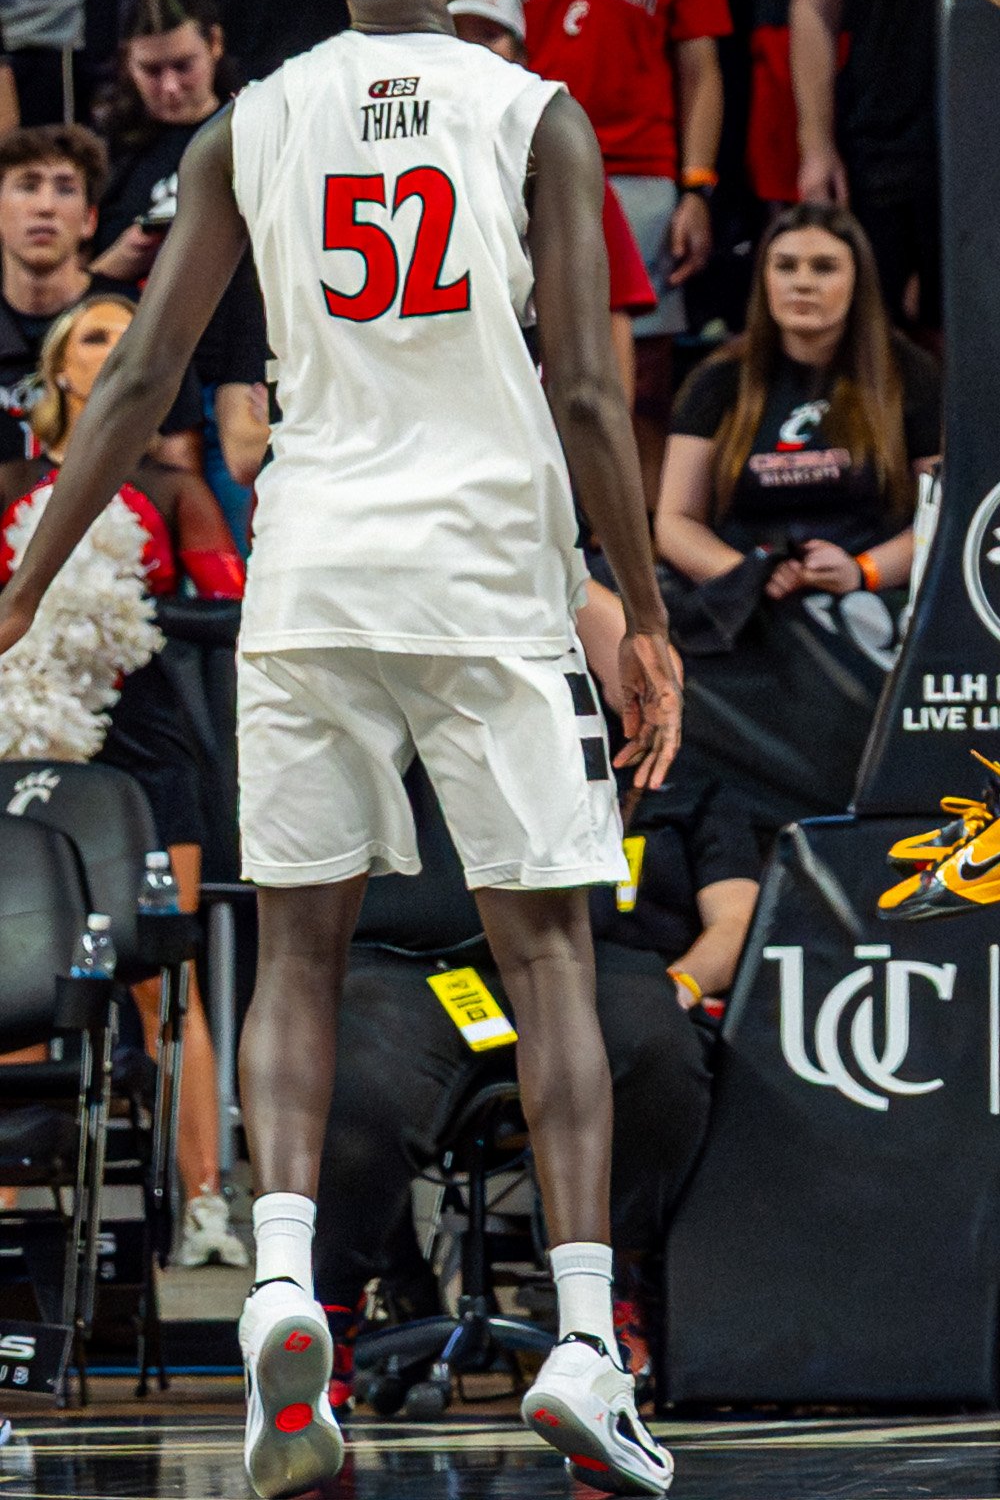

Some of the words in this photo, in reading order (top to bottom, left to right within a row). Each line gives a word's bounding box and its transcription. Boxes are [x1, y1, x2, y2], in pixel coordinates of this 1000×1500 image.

[360, 100, 431, 142] THIAM
[319, 165, 471, 323] 52
[922, 673, 988, 702] LLH
[902, 706, 967, 731] LIVE
